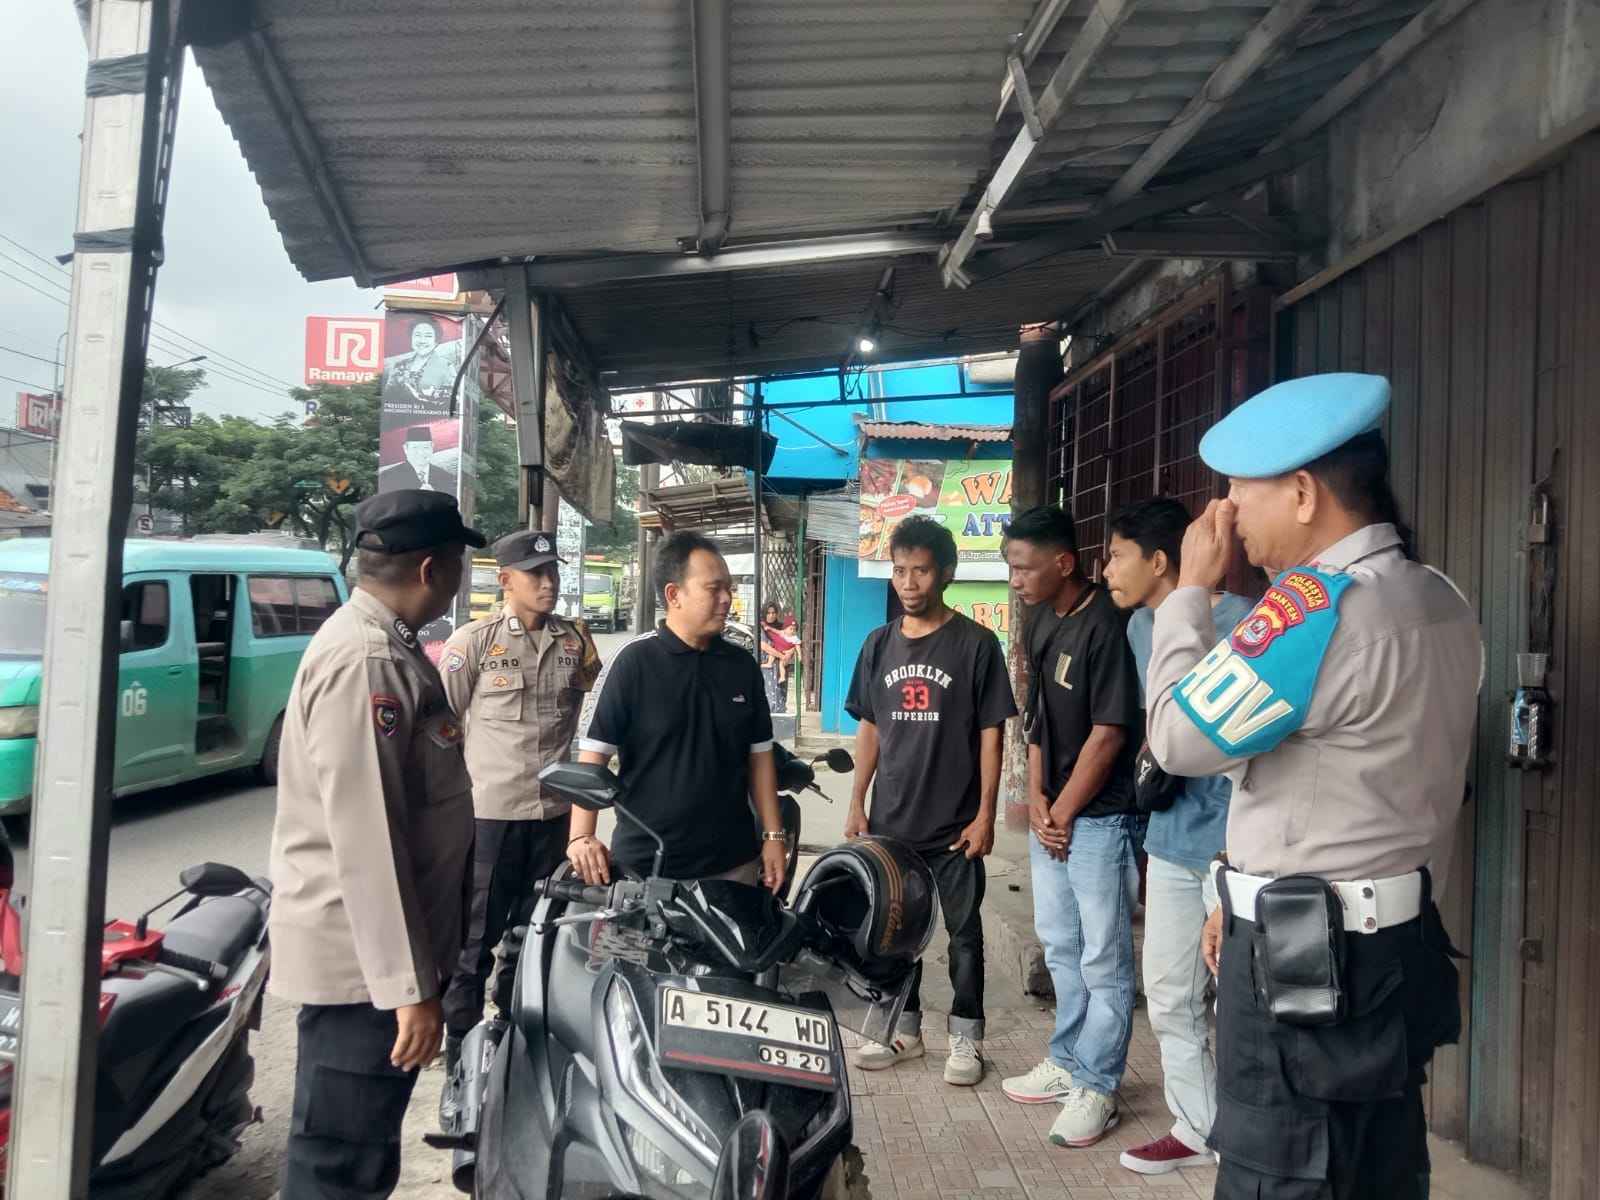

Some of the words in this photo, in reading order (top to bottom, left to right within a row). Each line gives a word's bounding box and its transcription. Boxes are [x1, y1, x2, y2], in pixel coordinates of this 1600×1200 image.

[953, 603, 1009, 632] RT
[1268, 591, 1298, 622] BANTEN
[884, 664, 953, 689] BROOKLYN
[122, 688, 147, 717] 06
[902, 685, 929, 710] 33
[891, 711, 940, 721] SUPERIOR
[671, 995, 685, 1021] A
[706, 1000, 769, 1034] 5144
[795, 1016, 827, 1046] WD
